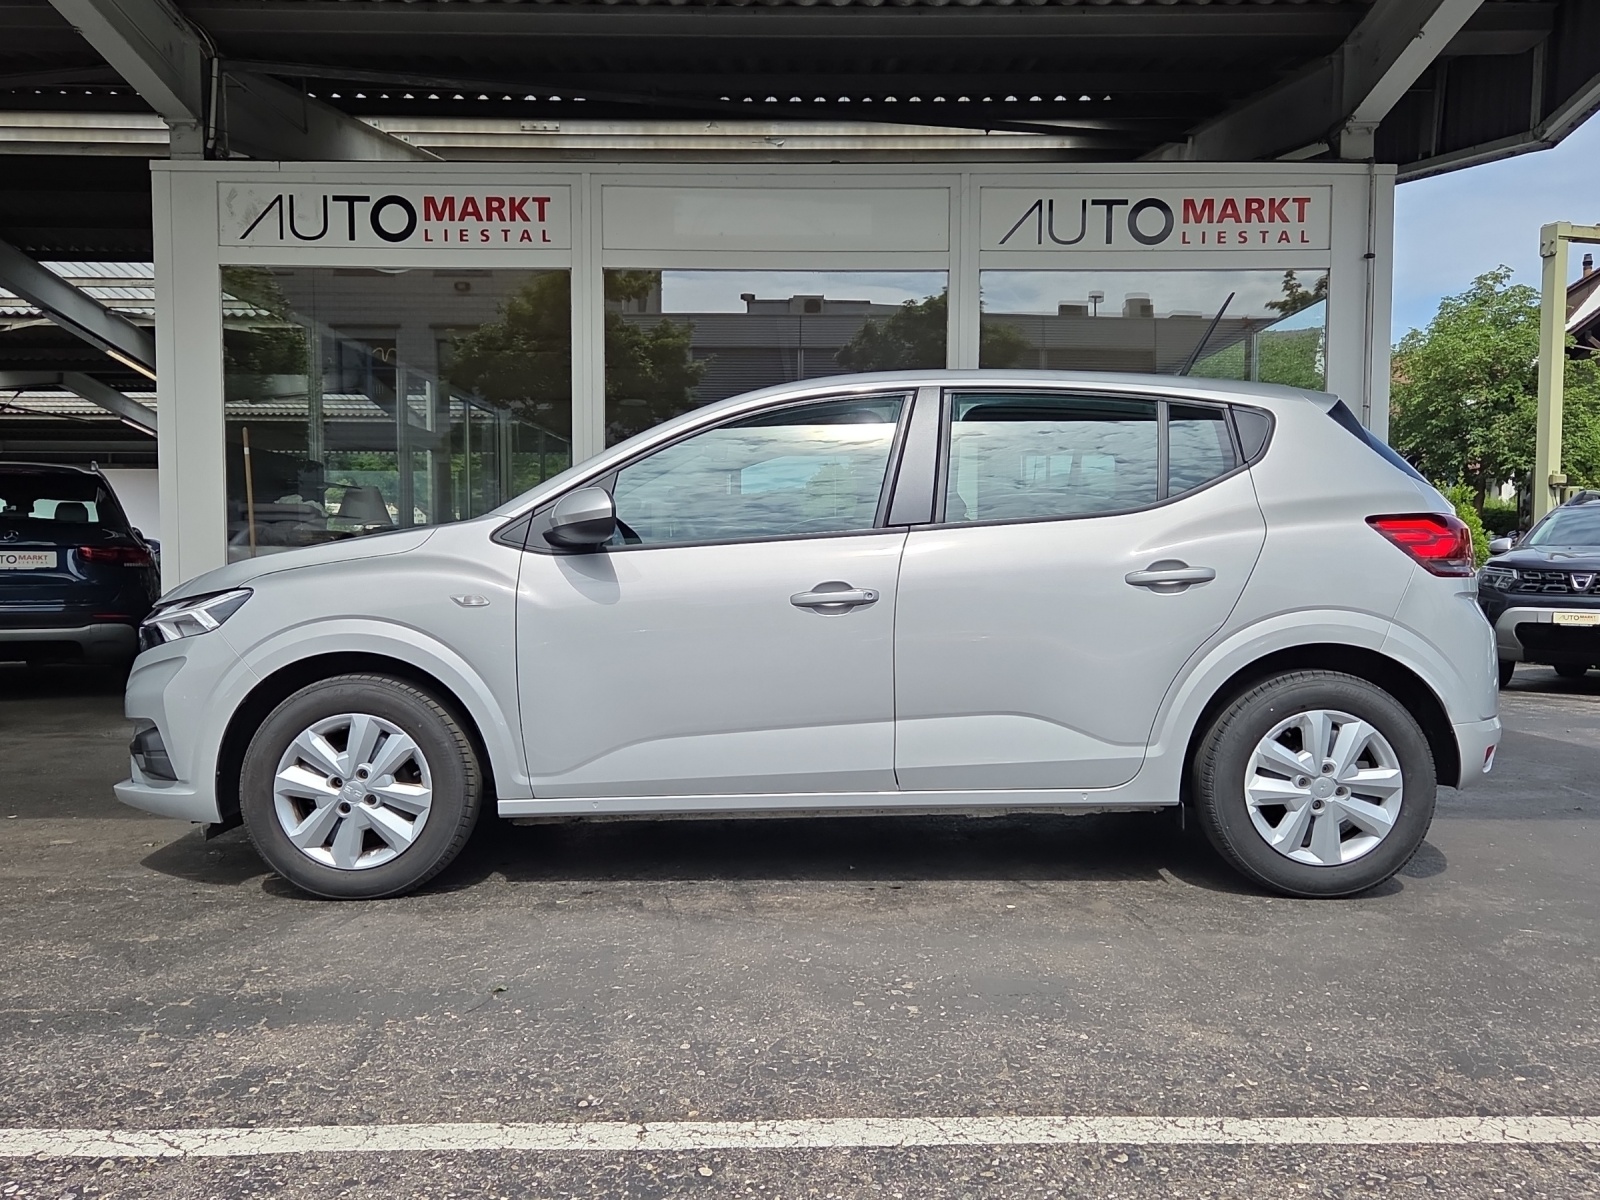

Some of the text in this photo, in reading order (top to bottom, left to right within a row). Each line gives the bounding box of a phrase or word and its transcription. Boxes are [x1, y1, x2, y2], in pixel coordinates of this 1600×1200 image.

[239, 194, 551, 243] AUTO MARKT
[998, 197, 1311, 245] AUTO MARKT
[424, 228, 552, 242] LIESTAL
[1182, 229, 1310, 244] LIESTAL
